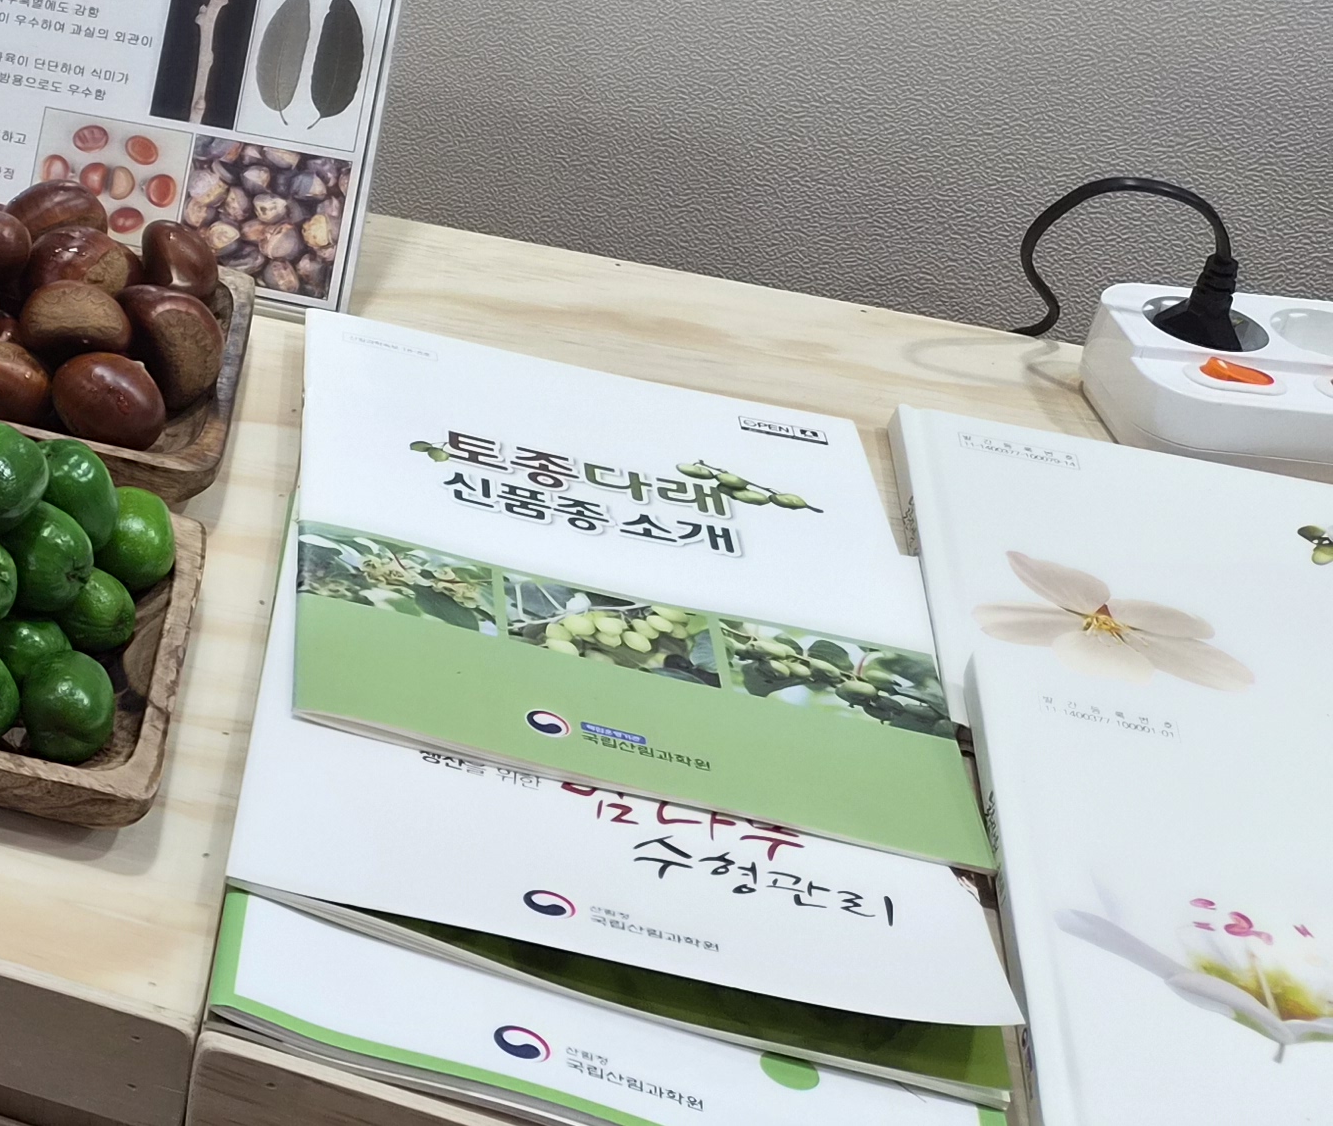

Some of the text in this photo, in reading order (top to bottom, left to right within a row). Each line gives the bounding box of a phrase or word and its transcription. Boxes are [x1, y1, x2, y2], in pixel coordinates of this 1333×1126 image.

[14, 14, 66, 33] 우수하여
[69, 23, 109, 41] 과실의
[113, 30, 153, 48] 외관이
[33, 57, 85, 77] 단단하여
[90, 68, 129, 85] 식미가
[743, 419, 790, 434] OPEN
[445, 429, 731, 517] 토종다래
[443, 471, 738, 556] 신품종 소개
[581, 732, 711, 772] 국립산림과학원
[632, 835, 894, 927] 수형관리
[589, 904, 630, 921] 산림청
[590, 915, 720, 953] 국립산림과학원
[564, 1046, 610, 1066] 산림청
[565, 1058, 705, 1113] 국립산림과학원
